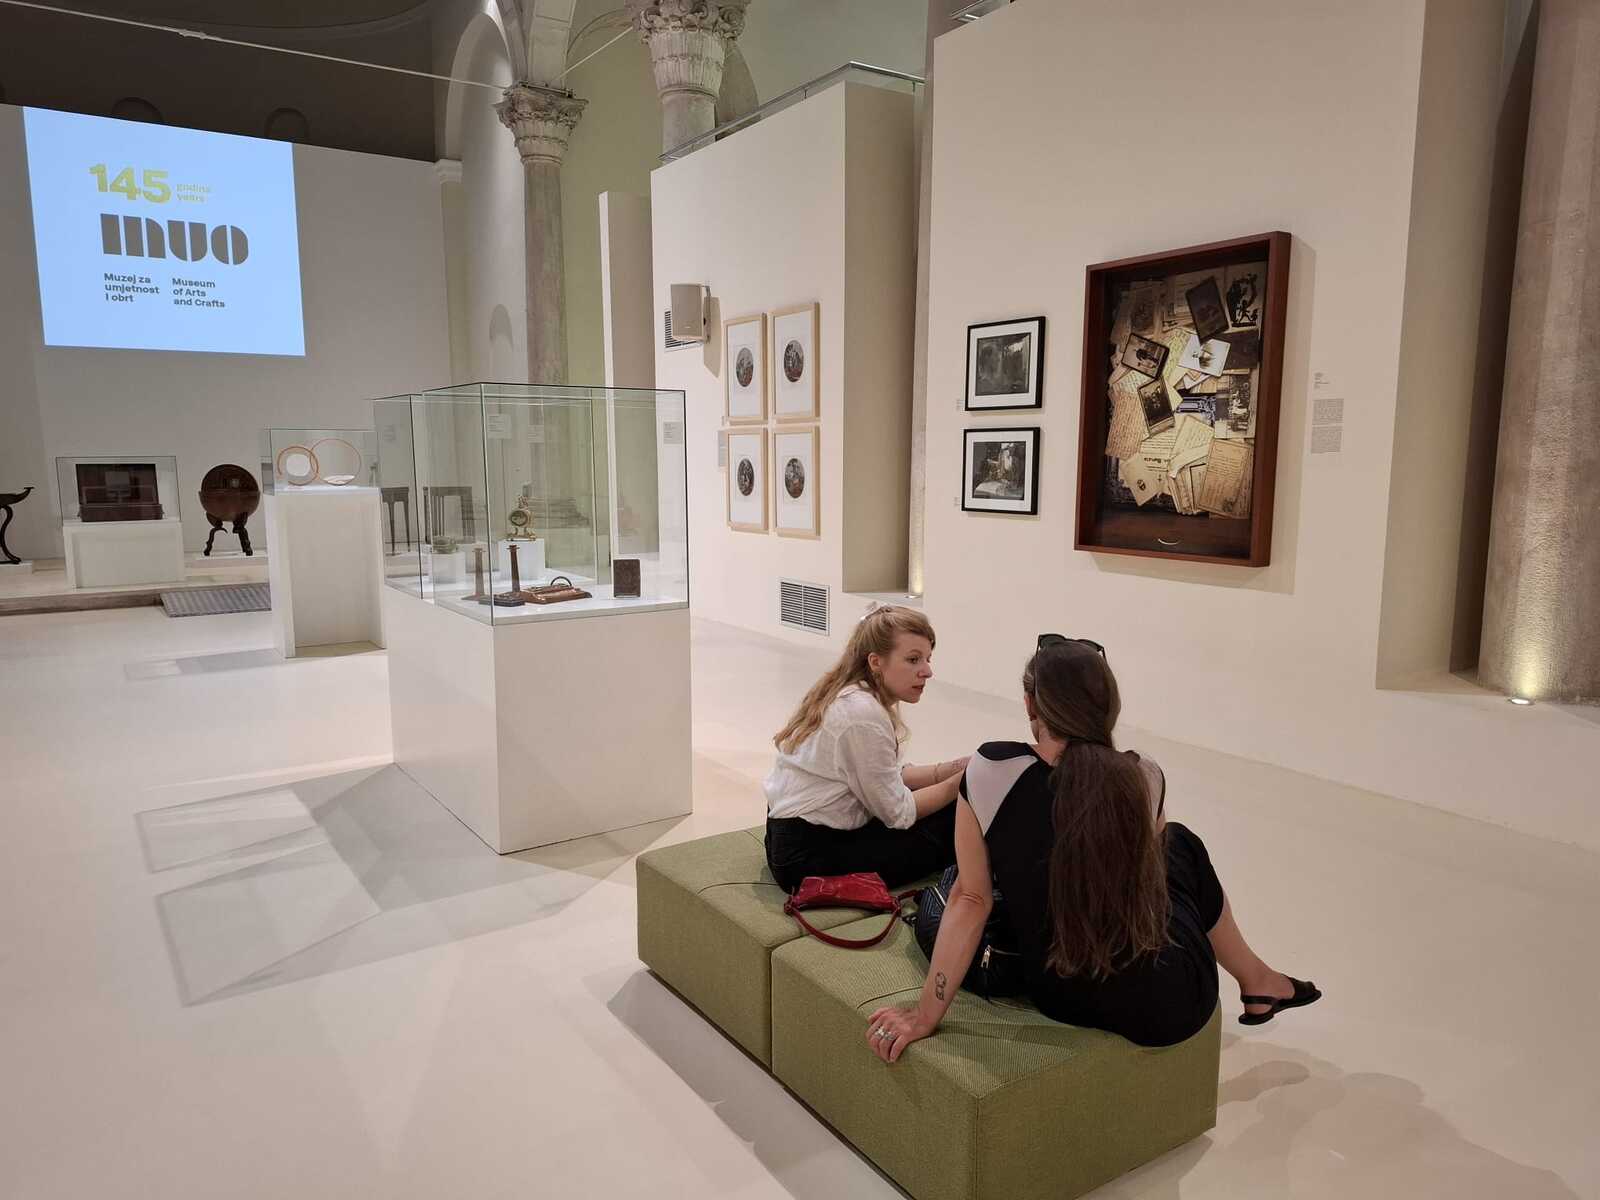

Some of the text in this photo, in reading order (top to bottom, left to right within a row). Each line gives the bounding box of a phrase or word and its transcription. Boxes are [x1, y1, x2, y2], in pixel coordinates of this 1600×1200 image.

[88, 163, 171, 203] 145
[104, 273, 151, 284] Muzej za
[172, 278, 216, 288] Museum
[105, 283, 160, 294] umjetnost
[173, 288, 206, 297] of Arts
[111, 294, 134, 302] obrt
[173, 297, 225, 308] and Crafts
